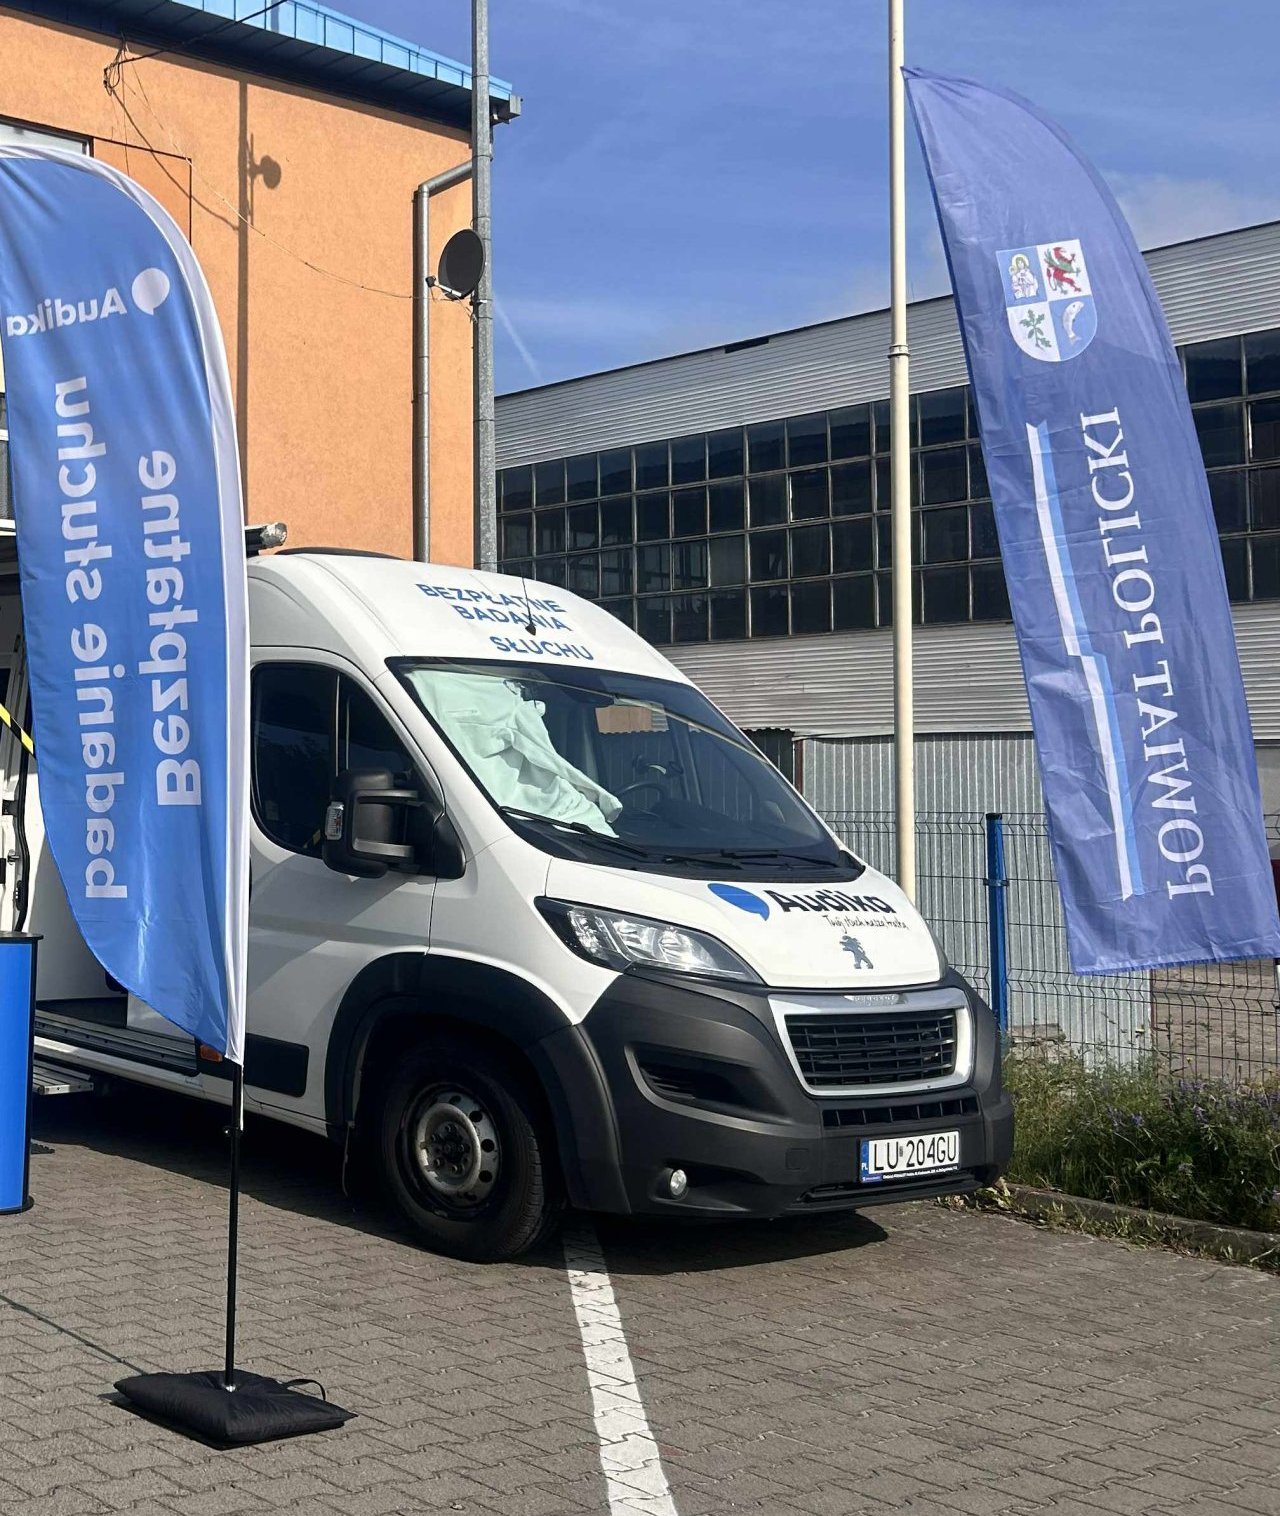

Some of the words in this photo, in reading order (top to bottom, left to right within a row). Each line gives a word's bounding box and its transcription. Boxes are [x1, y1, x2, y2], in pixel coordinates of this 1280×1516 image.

[415, 583, 567, 613] BEZPŁATNE
[451, 604, 573, 632] BADANIA
[489, 636, 594, 661] SŁUCHU
[763, 888, 897, 914] Audika
[874, 1141, 899, 1171] LU
[906, 1135, 957, 1168] 204GU
